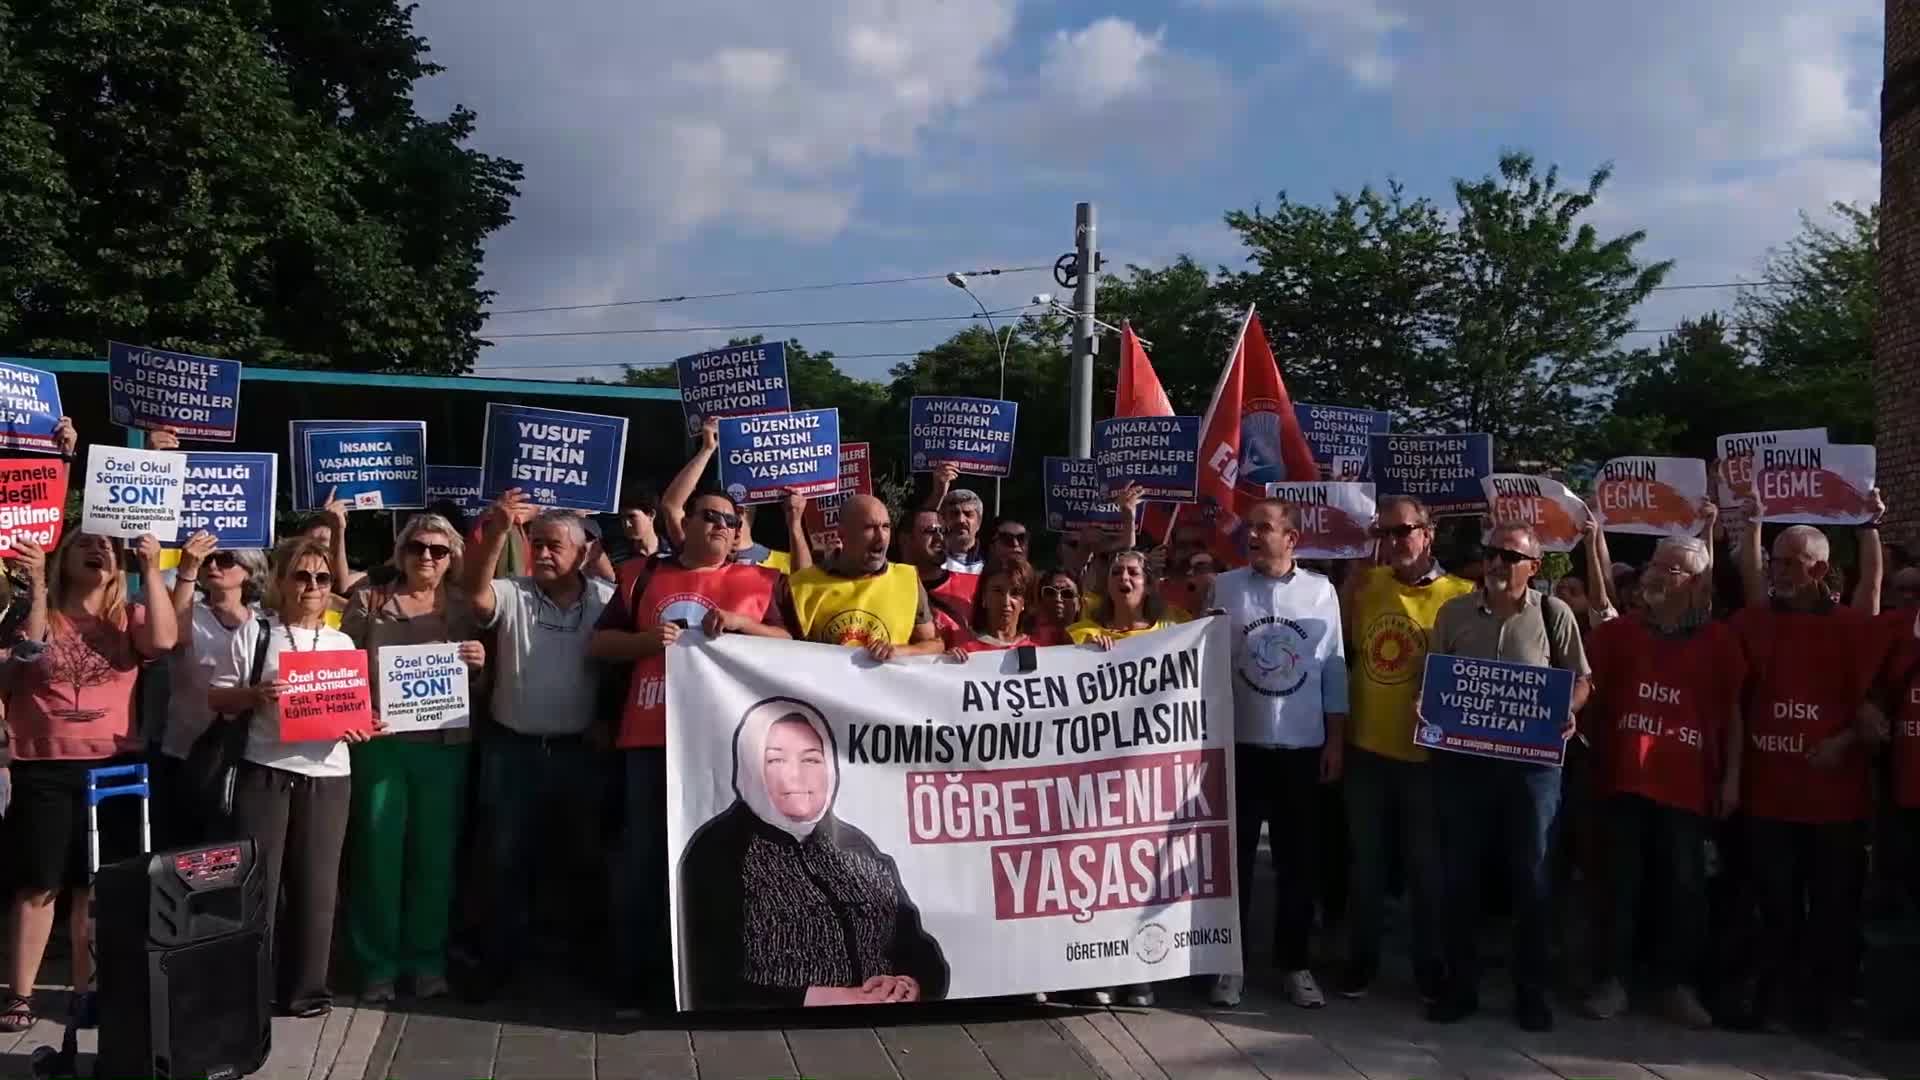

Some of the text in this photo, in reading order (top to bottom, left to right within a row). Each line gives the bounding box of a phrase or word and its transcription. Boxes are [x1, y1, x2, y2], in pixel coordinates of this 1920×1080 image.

[128, 351, 219, 377] MÜCADELE
[690, 349, 766, 372] MÜCADELE
[136, 369, 208, 391] DERSİNİ
[699, 362, 760, 384] DERSİNİ
[113, 376, 233, 408] ÖĞRETMENLER
[683, 377, 784, 402] ÖĞRETMENLER
[130, 398, 210, 422] VERİYOR!
[697, 393, 766, 414] VERİYOR!
[925, 401, 1000, 416] ANKARA'DA
[741, 413, 820, 435] DÜZENİNİZ
[1310, 407, 1374, 424] ÖĞRETMEN
[518, 422, 592, 444] YUSUF
[914, 424, 1010, 442] ÖĞRETMENLERE
[1104, 421, 1181, 436] ANKARA'DA
[1314, 420, 1369, 435] DÜŞMANI
[339, 441, 393, 454] İNSANCA
[753, 431, 811, 449] BATSIN!
[925, 437, 995, 453] BİN SELAM!
[1111, 435, 1169, 449] DİRENEN
[1304, 431, 1368, 446] YUSUF TEKİ
[1388, 437, 1467, 451] ÖĞRETMEN
[519, 443, 585, 465] TEKİN
[729, 444, 832, 465] ÖĞRETMENLER
[1097, 450, 1194, 465] ÖĞRETMENLERE
[1320, 443, 1361, 456] İSTİFA!
[105, 457, 172, 473] Özel Okul
[319, 454, 414, 469] YAŞANACAK BİR
[1393, 451, 1463, 467] DÜŞMANI
[1764, 447, 1821, 471] BOYUN
[184, 464, 250, 480] RANLIĞI
[315, 469, 418, 483] ÜCRET İSTİYORUZ
[512, 458, 588, 486] İSTİFA!
[749, 460, 817, 480] YAŞASIN!
[1106, 463, 1177, 478] BİN SELAM!
[1384, 465, 1475, 479] YUSUF TEKİN
[1604, 460, 1656, 481] BOYUN
[96, 472, 178, 487] Sömürüsüne
[1403, 479, 1455, 493] İSTİFA!
[1494, 478, 1542, 497] BOYUN
[109, 485, 165, 506] SON!
[184, 482, 244, 499] RÇALA
[533, 487, 557, 499] SOL
[182, 497, 246, 512] LECEĞE
[0, 505, 60, 529] ğitime
[179, 513, 248, 531] HİP ÇIK!
[394, 652, 454, 669] Özel Okul
[288, 667, 359, 683] Özel Okullar
[388, 666, 463, 682] Sömürüsüne
[1452, 659, 1547, 687] ÖĞRETMEN
[401, 677, 452, 699] SON!
[962, 675, 1069, 717] AYŞEN
[1078, 648, 1200, 702] GÜRCAN
[1457, 677, 1539, 701] DÜŞMANI
[1639, 681, 1680, 704] DİSK
[285, 707, 322, 720] Eğitim
[1440, 692, 1551, 720] YUSUF TEKİN
[1774, 699, 1819, 720] DİSK
[416, 711, 443, 722] ücret!
[1461, 708, 1525, 733] İSTİFA!
[848, 699, 1209, 764] KOMİSYONU TOPLASIN!
[911, 754, 1212, 841] ÖĞRETMENLİK
[998, 832, 1215, 924] YAŞASIN!
[1066, 939, 1129, 962] ÖĞRETMEN
